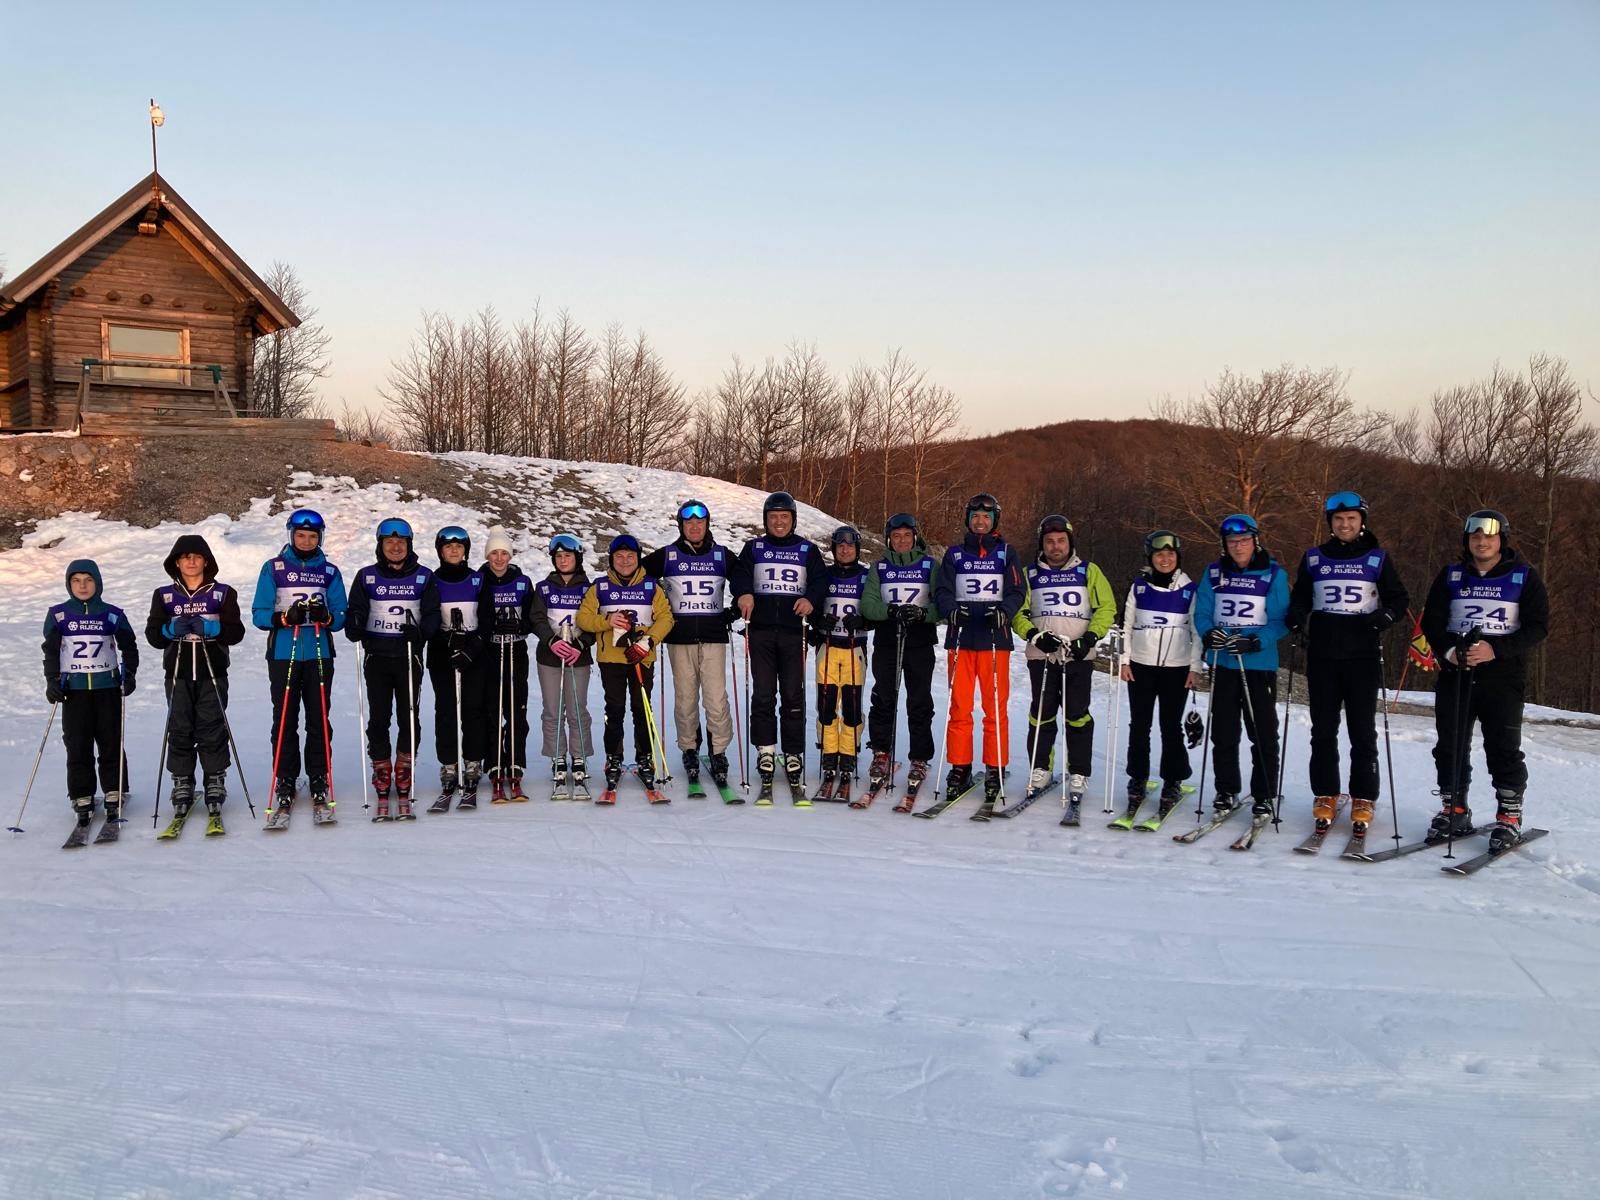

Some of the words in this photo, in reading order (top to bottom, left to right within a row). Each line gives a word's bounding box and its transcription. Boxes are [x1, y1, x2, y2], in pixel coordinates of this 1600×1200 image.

[765, 568, 798, 582] 18
[682, 581, 715, 596] 15
[762, 583, 802, 592] Platak
[966, 579, 999, 594] 34
[889, 588, 920, 603] 17
[1042, 591, 1081, 606] 30
[1323, 586, 1363, 603] 35
[680, 601, 719, 610] Platak
[1221, 599, 1255, 618] 32
[1464, 605, 1508, 622] 24
[374, 620, 400, 630] Plat
[73, 641, 104, 658] 27
